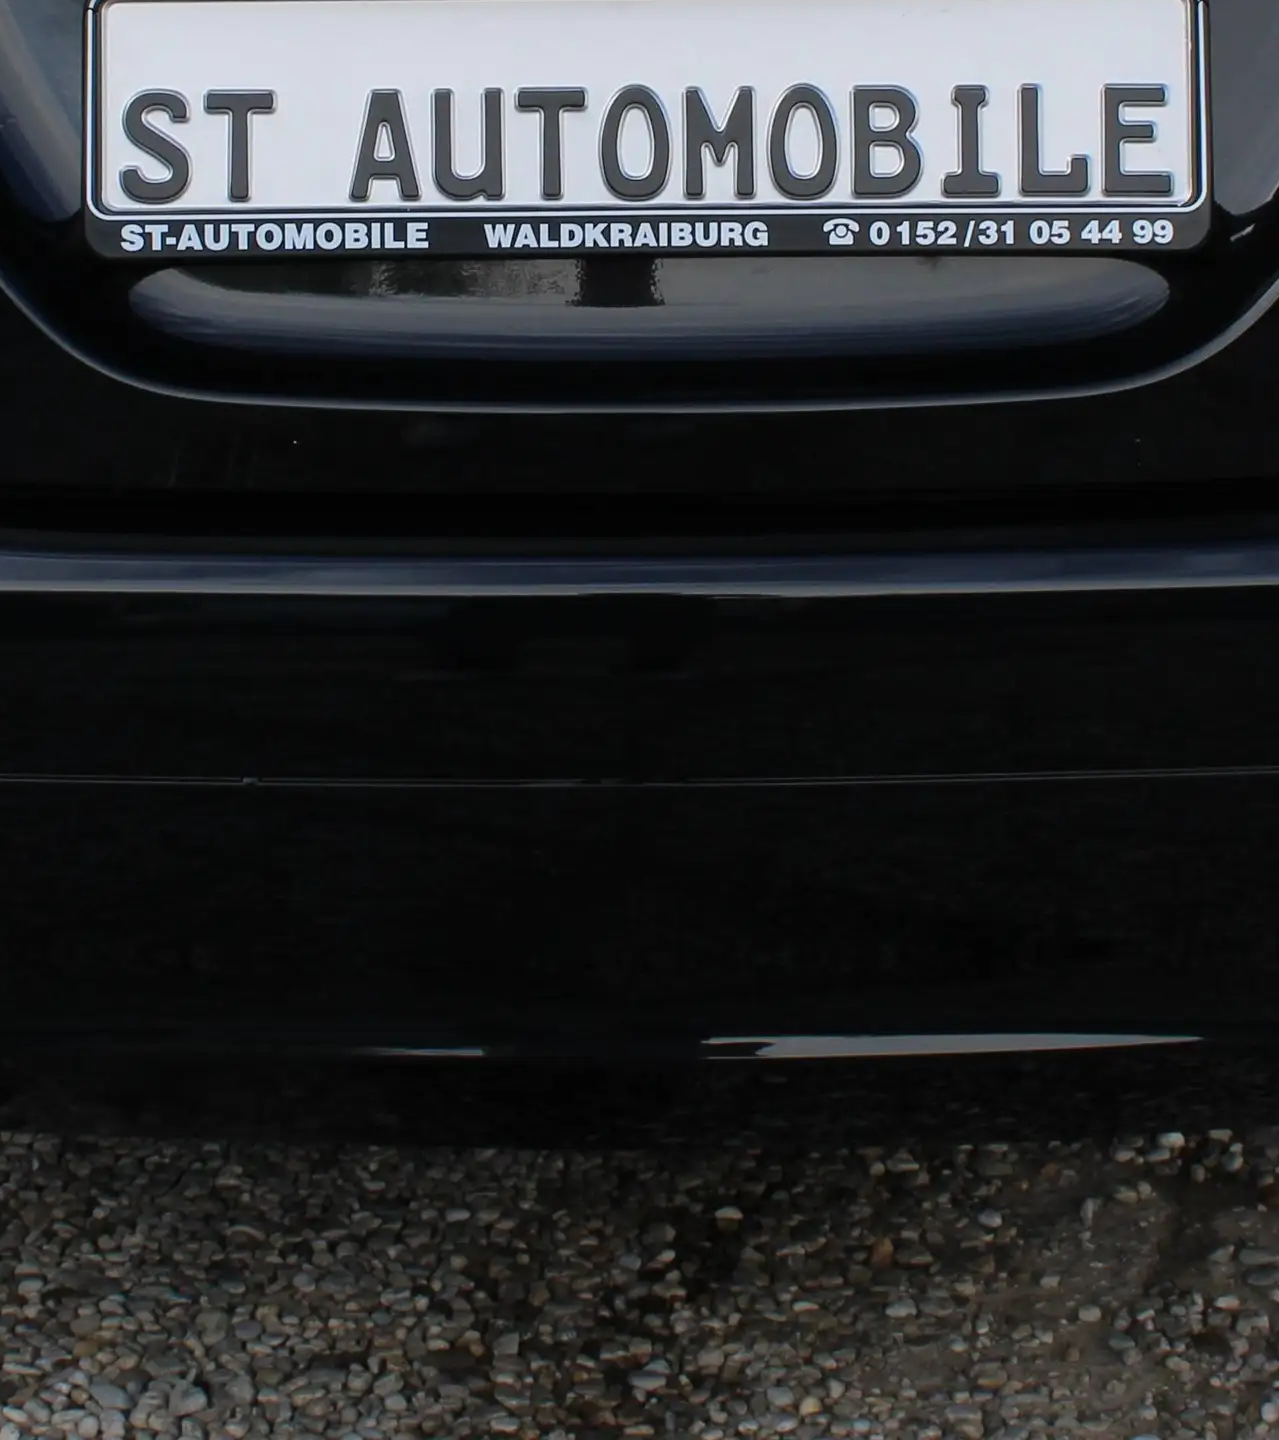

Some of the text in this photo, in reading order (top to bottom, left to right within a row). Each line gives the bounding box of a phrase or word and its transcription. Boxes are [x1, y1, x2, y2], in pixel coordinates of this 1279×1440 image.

[119, 83, 1174, 204] ST AUTOMOBILE
[120, 222, 429, 251] ST-AUTOMOBILE
[484, 221, 769, 249] WALDKRAIBURG
[1029, 219, 1070, 245] 05
[1081, 219, 1122, 244] 44
[1132, 219, 1174, 244] 99
